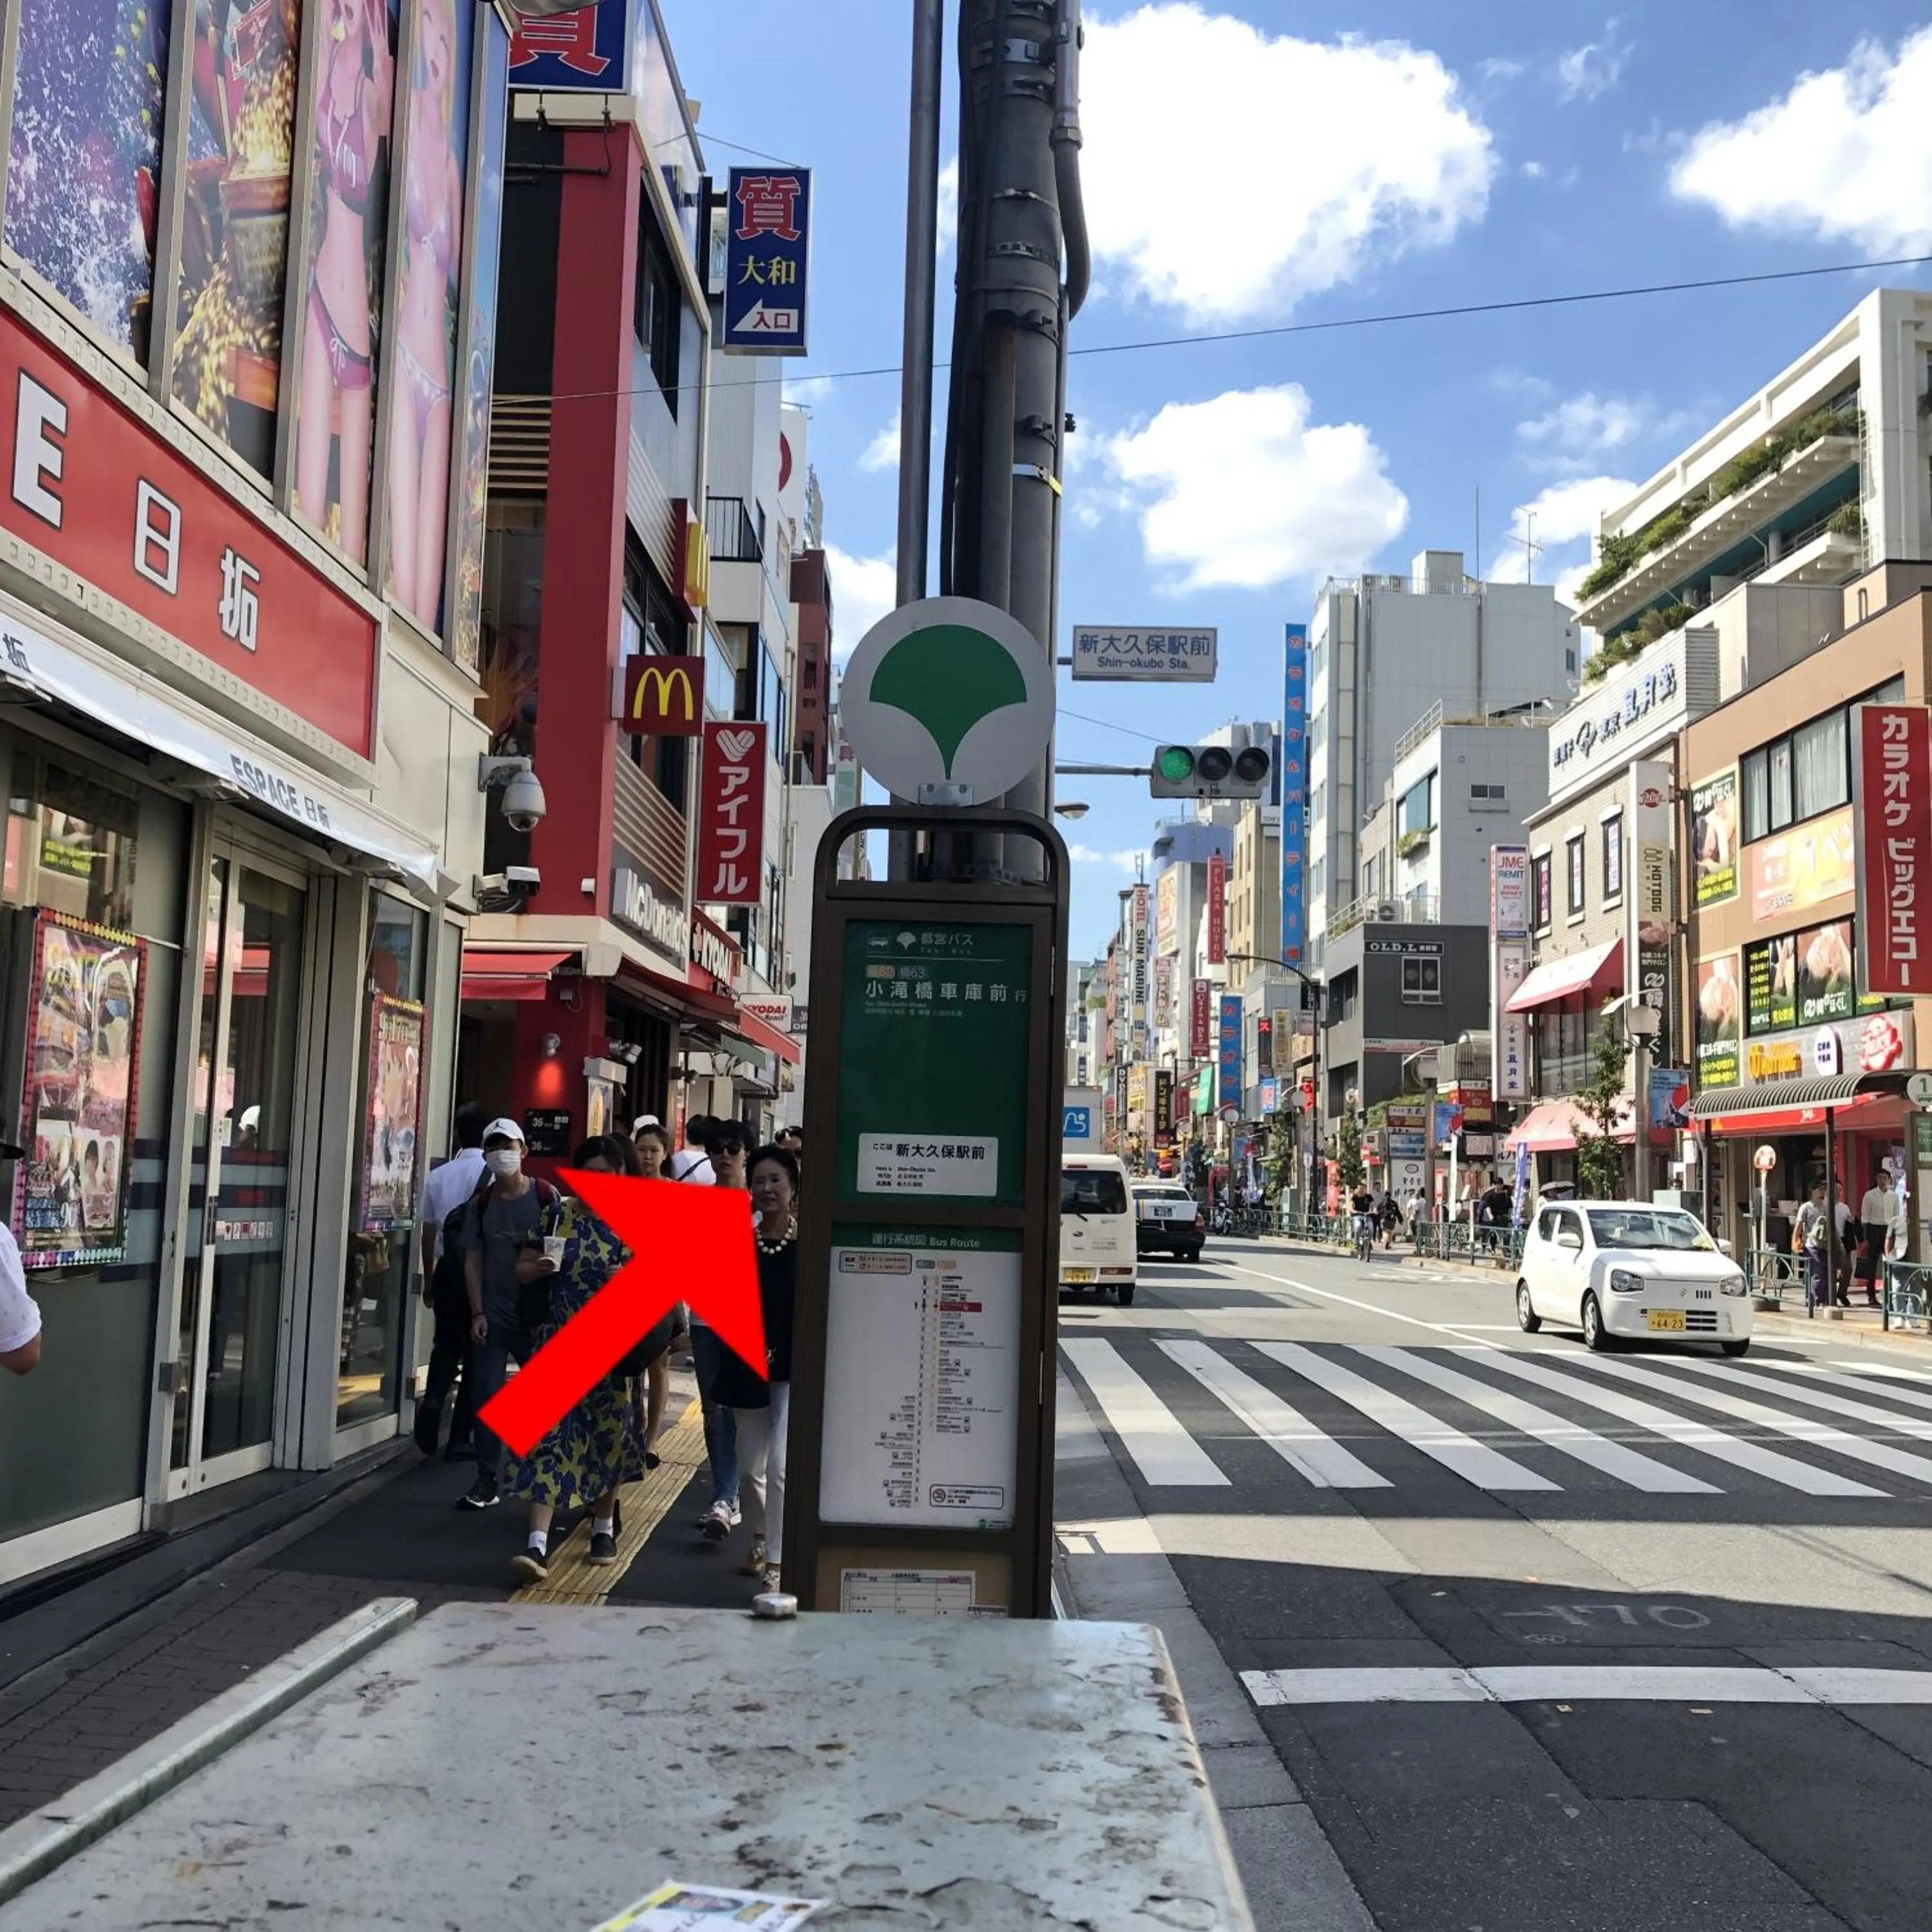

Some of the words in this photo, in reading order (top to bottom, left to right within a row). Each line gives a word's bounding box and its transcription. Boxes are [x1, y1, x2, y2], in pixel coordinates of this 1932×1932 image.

[735, 176, 802, 242] 質
[737, 255, 796, 285] 大和
[752, 312, 791, 329] 入口
[11, 366, 68, 532] E
[0, 632, 31, 674] 拓
[1079, 634, 1210, 656] 新大久保駅前
[1097, 656, 1164, 669] Shin-okubo
[1169, 658, 1190, 670] Sta.
[231, 754, 301, 817] ESPACE
[1882, 714, 1912, 827] カラオケ
[713, 766, 750, 895] アイフル
[1499, 857, 1524, 868] JME
[1499, 870, 1524, 878] REMIT
[1652, 865, 1662, 913] HOTDOG
[1135, 889, 1146, 922] HOTEL
[1887, 837, 1917, 987] ビッグエコー
[1136, 929, 1145, 954] SUN
[866, 980, 1008, 1002] 小滝橋車庫前
[1014, 990, 1027, 1003] 行
[1135, 959, 1144, 1005] MARINE
[896, 1143, 985, 1160] 新大久保駅前
[930, 1237, 947, 1247] Bus
[951, 1238, 980, 1248] Route
